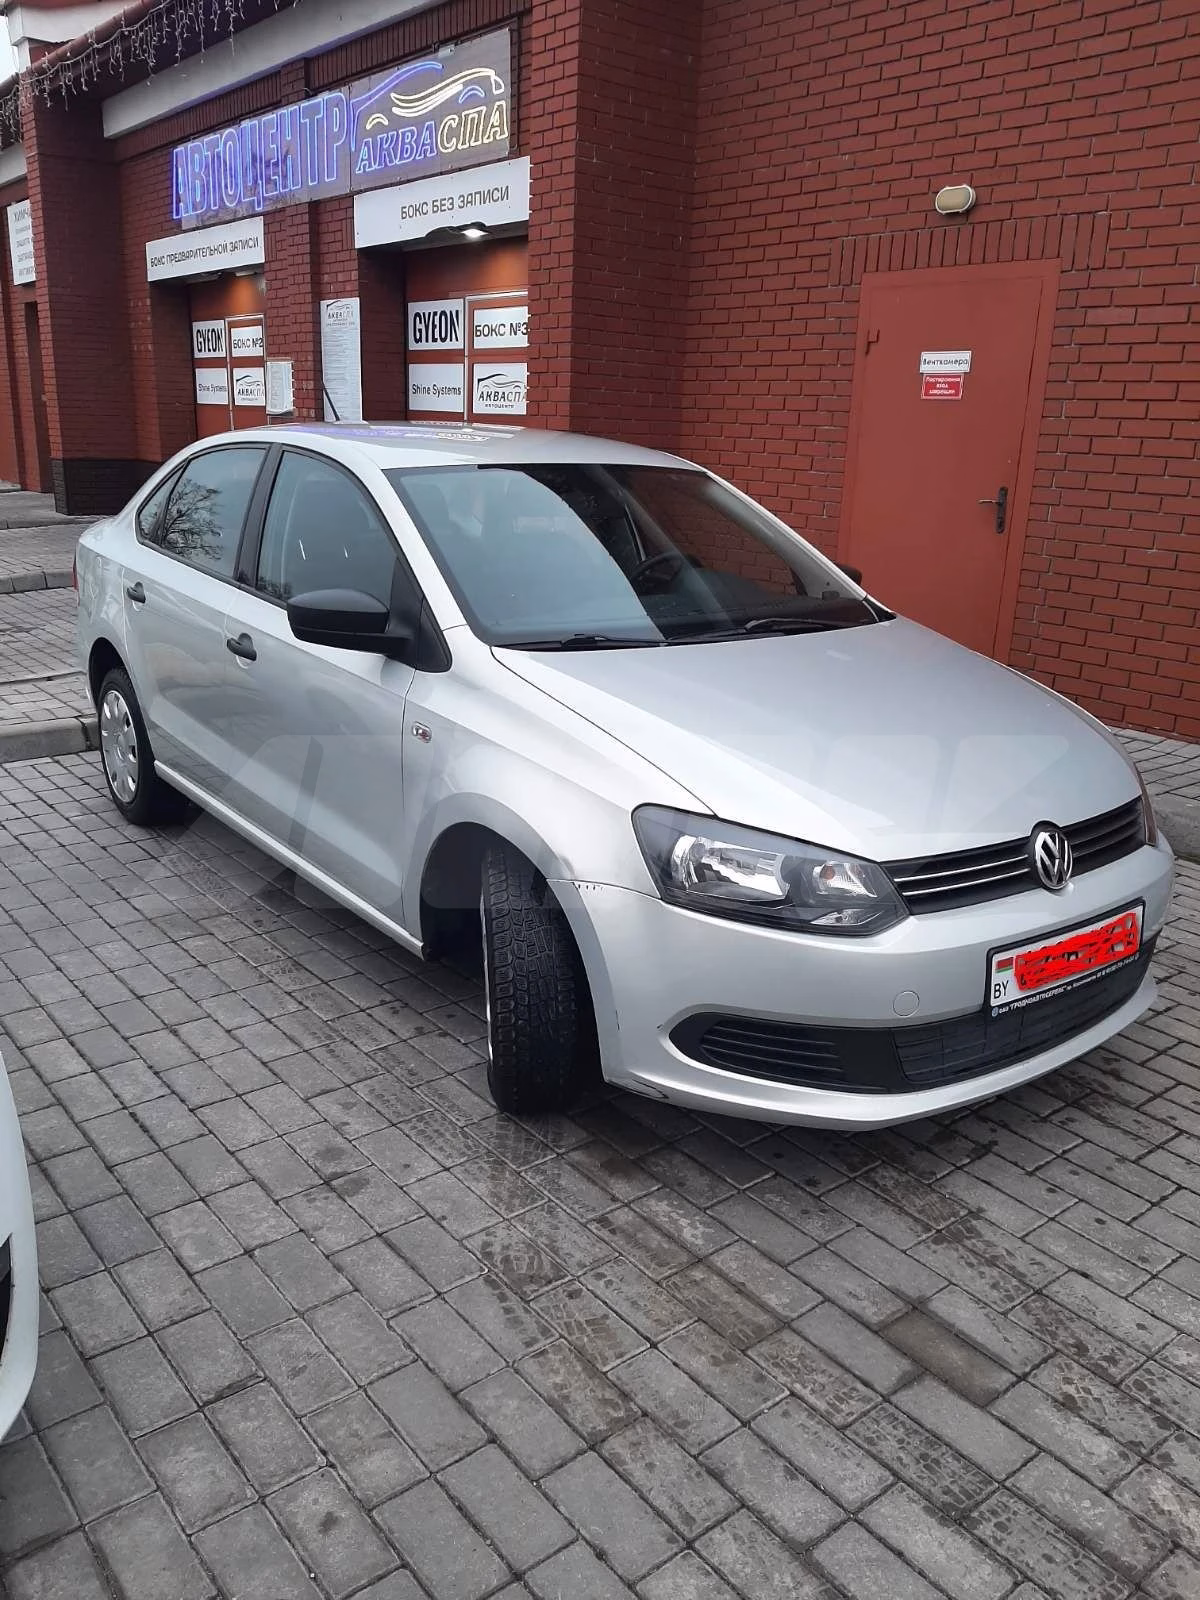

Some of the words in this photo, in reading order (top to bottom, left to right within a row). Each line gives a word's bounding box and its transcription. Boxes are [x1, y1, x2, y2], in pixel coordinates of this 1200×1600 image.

[355, 100, 509, 174] АКВАСПА
[172, 92, 348, 219] АВТОЦЕНТР
[401, 202, 429, 220] БОКС
[432, 197, 455, 215] БЕЗ
[458, 185, 510, 209] ЗАПИСИ
[150, 257, 166, 268] БОКС
[166, 240, 228, 265] ПРЕДВАРИТЕЛЬНОЙ
[229, 236, 260, 252] ЗАПИСИ
[196, 328, 224, 353] GYEON
[413, 309, 459, 344] GYEON
[474, 323, 506, 338] БОКС
[510, 321, 528, 337] №3
[233, 338, 251, 349] БОКС
[412, 383, 431, 395] Shine
[432, 383, 462, 398] Systems
[993, 979, 1009, 999] BY
